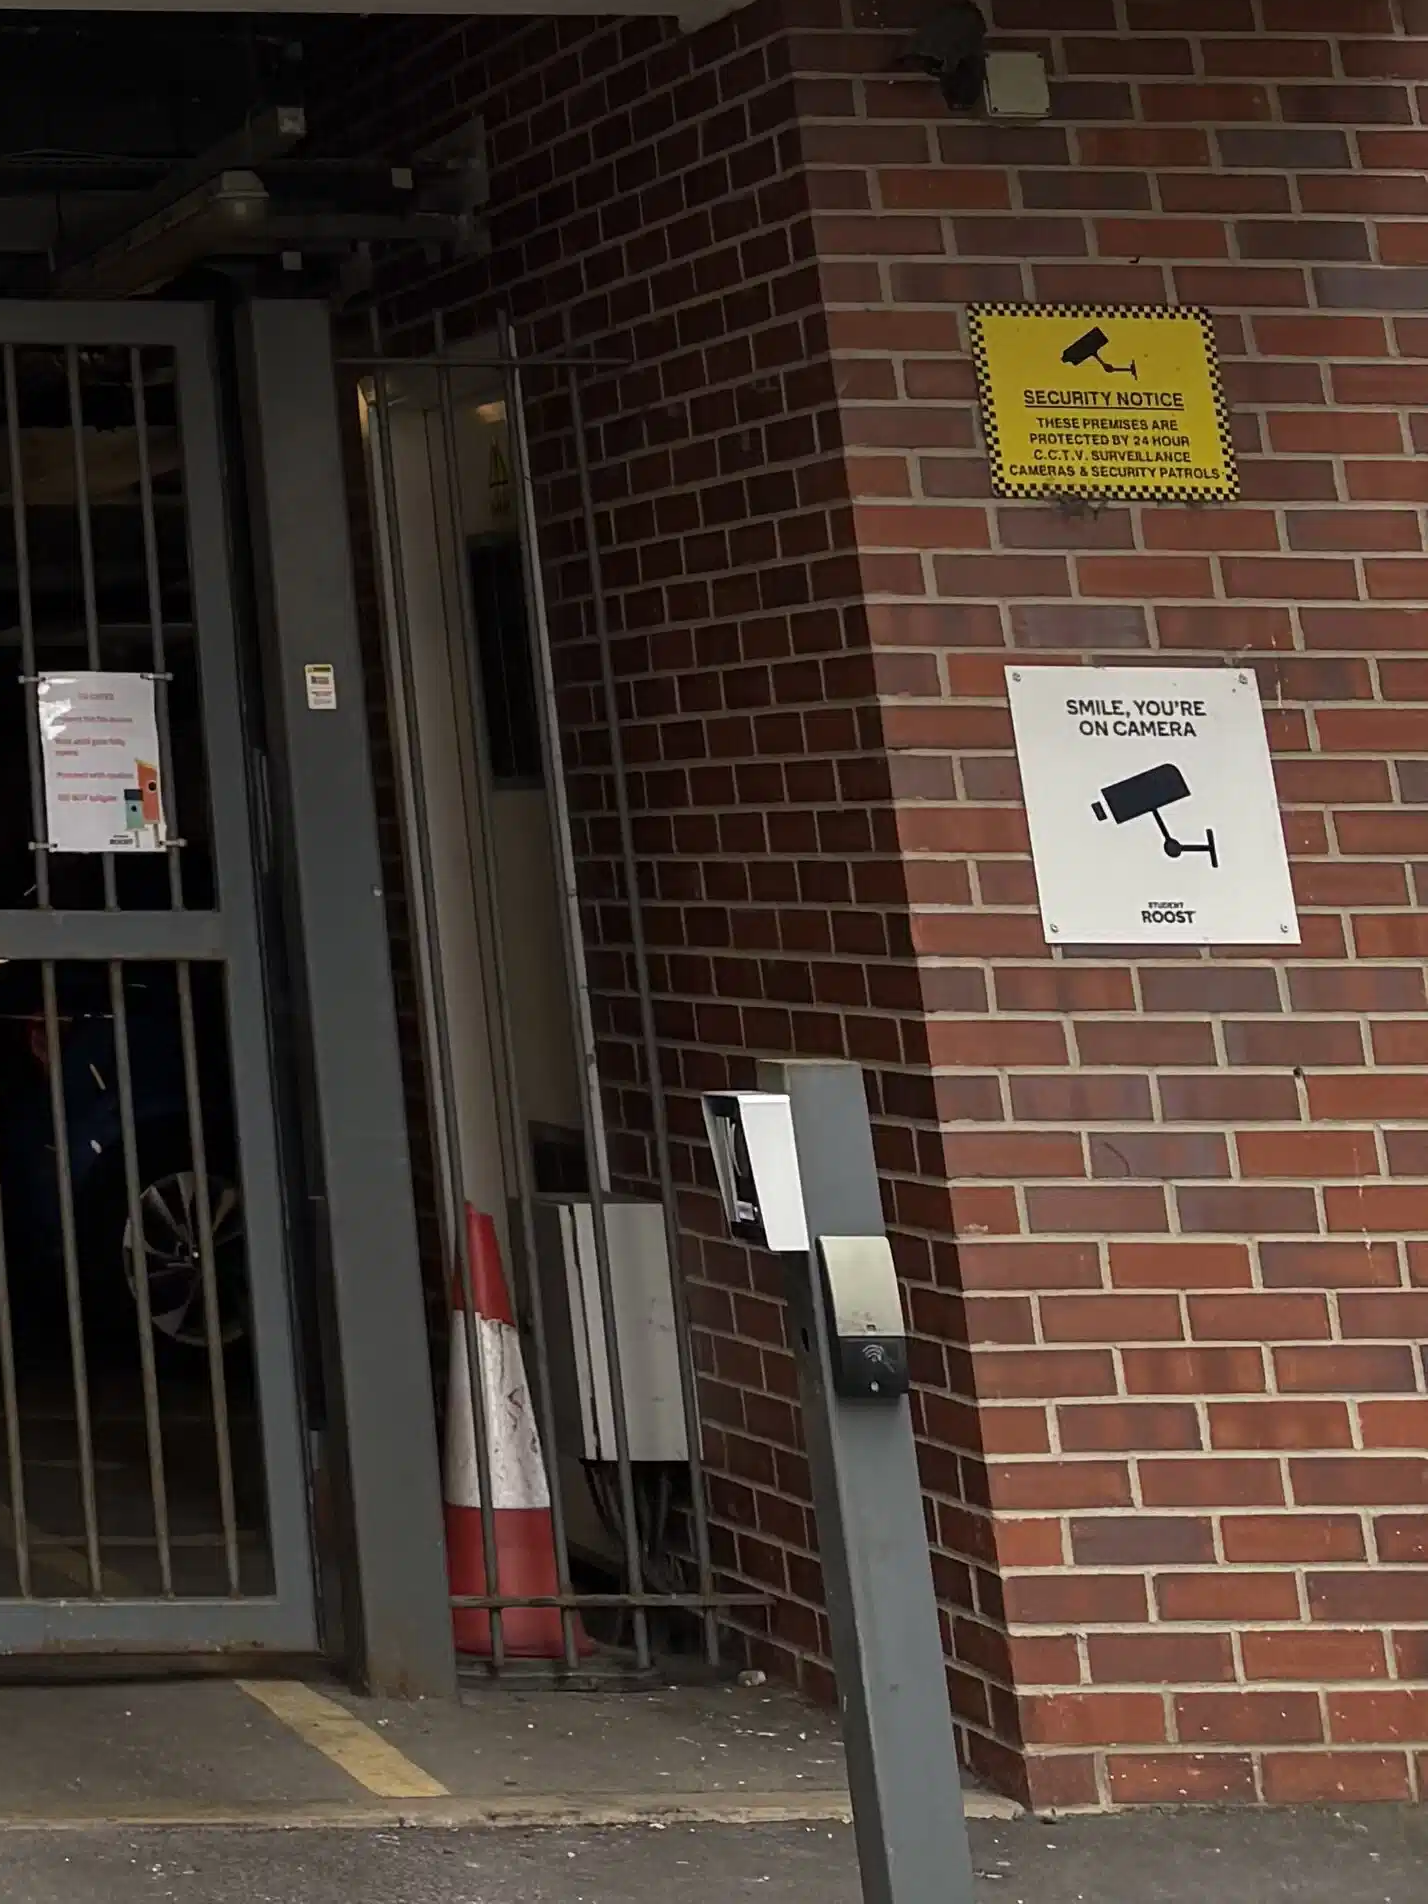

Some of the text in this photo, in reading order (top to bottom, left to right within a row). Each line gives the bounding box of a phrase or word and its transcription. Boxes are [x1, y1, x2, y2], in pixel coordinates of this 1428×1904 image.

[1024, 389, 1185, 407] SECURITY NOTICE
[1036, 417, 1179, 431] THESE PREMISES ARE
[1029, 433, 1190, 447] PROTECTED BY 24 HOUR
[1033, 449, 1192, 462] C.C.T.V. SURVEILLANCE
[1009, 464, 1221, 480] CAMERAS & SECURITY PATROLS
[1066, 699, 1207, 719] SMILE, YOU'RE
[1079, 720, 1197, 737] ON CAMERA
[1141, 910, 1197, 924] ROOST
